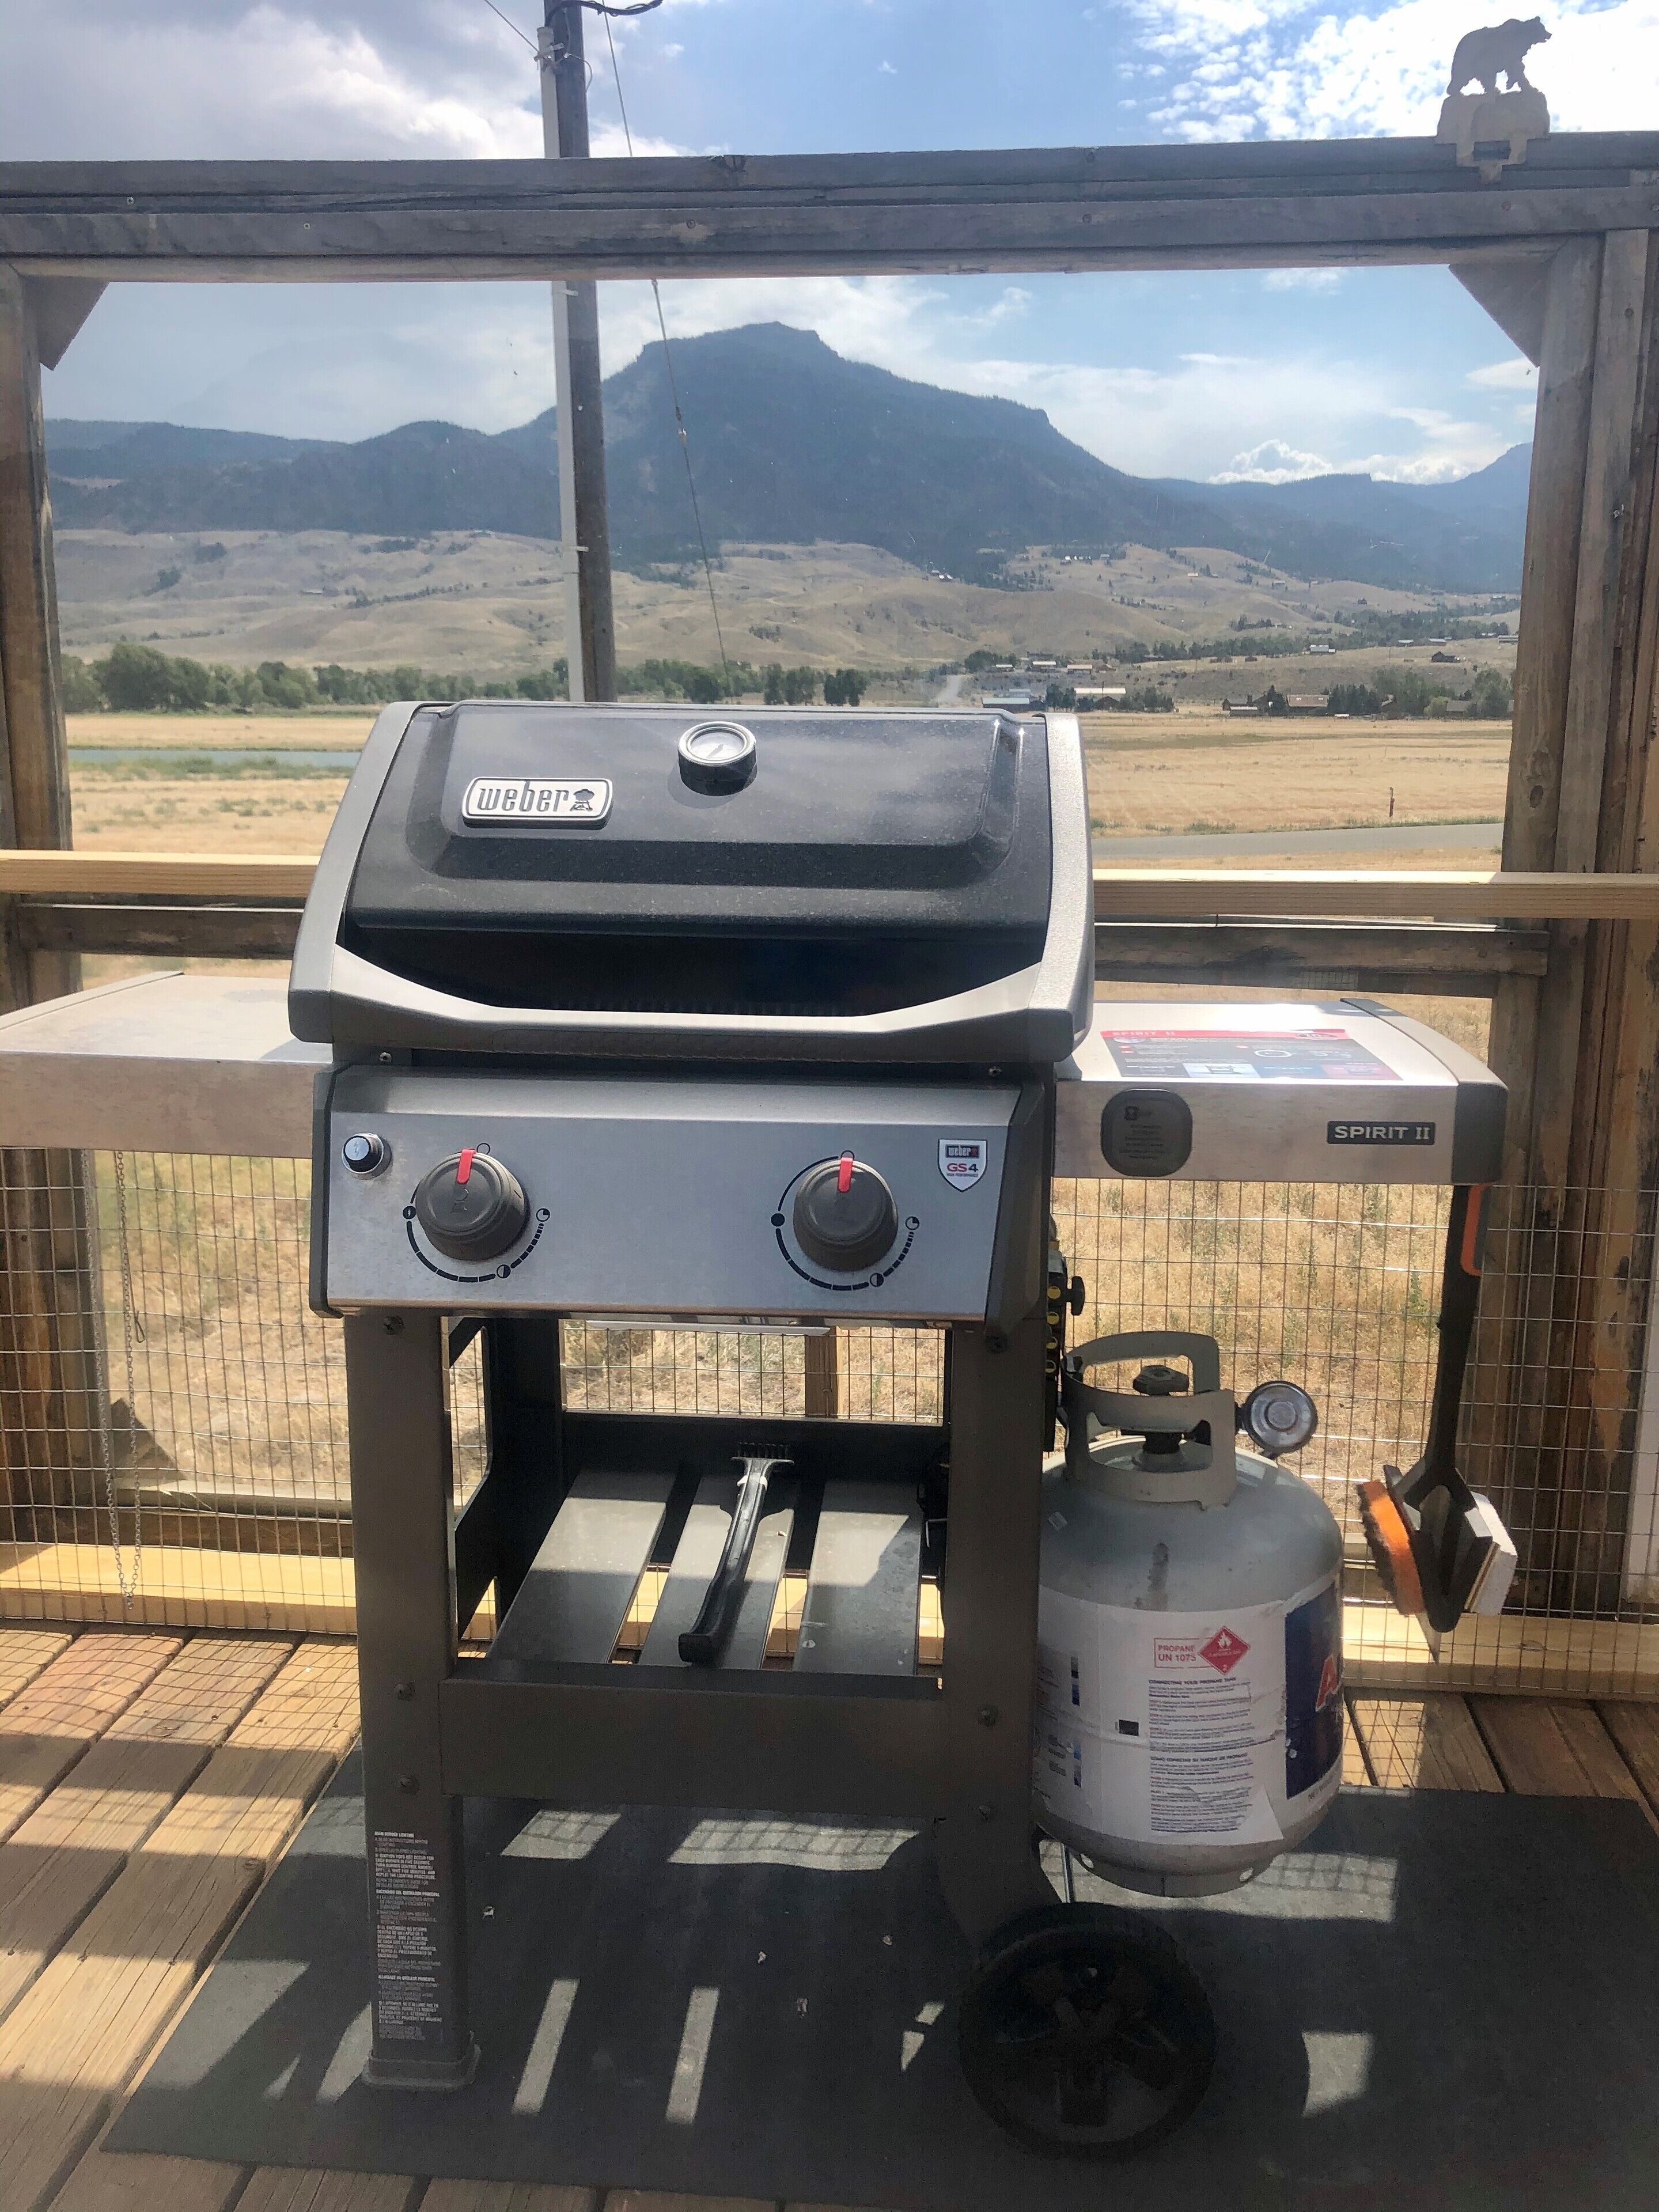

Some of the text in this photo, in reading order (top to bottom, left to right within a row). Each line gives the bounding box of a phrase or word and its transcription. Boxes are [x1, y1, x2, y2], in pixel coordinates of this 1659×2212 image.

[476, 781, 570, 812] weber
[1334, 1125, 1430, 1140] SPIRIT II
[948, 1145, 971, 1156] weber
[946, 1163, 979, 1172] GS4
